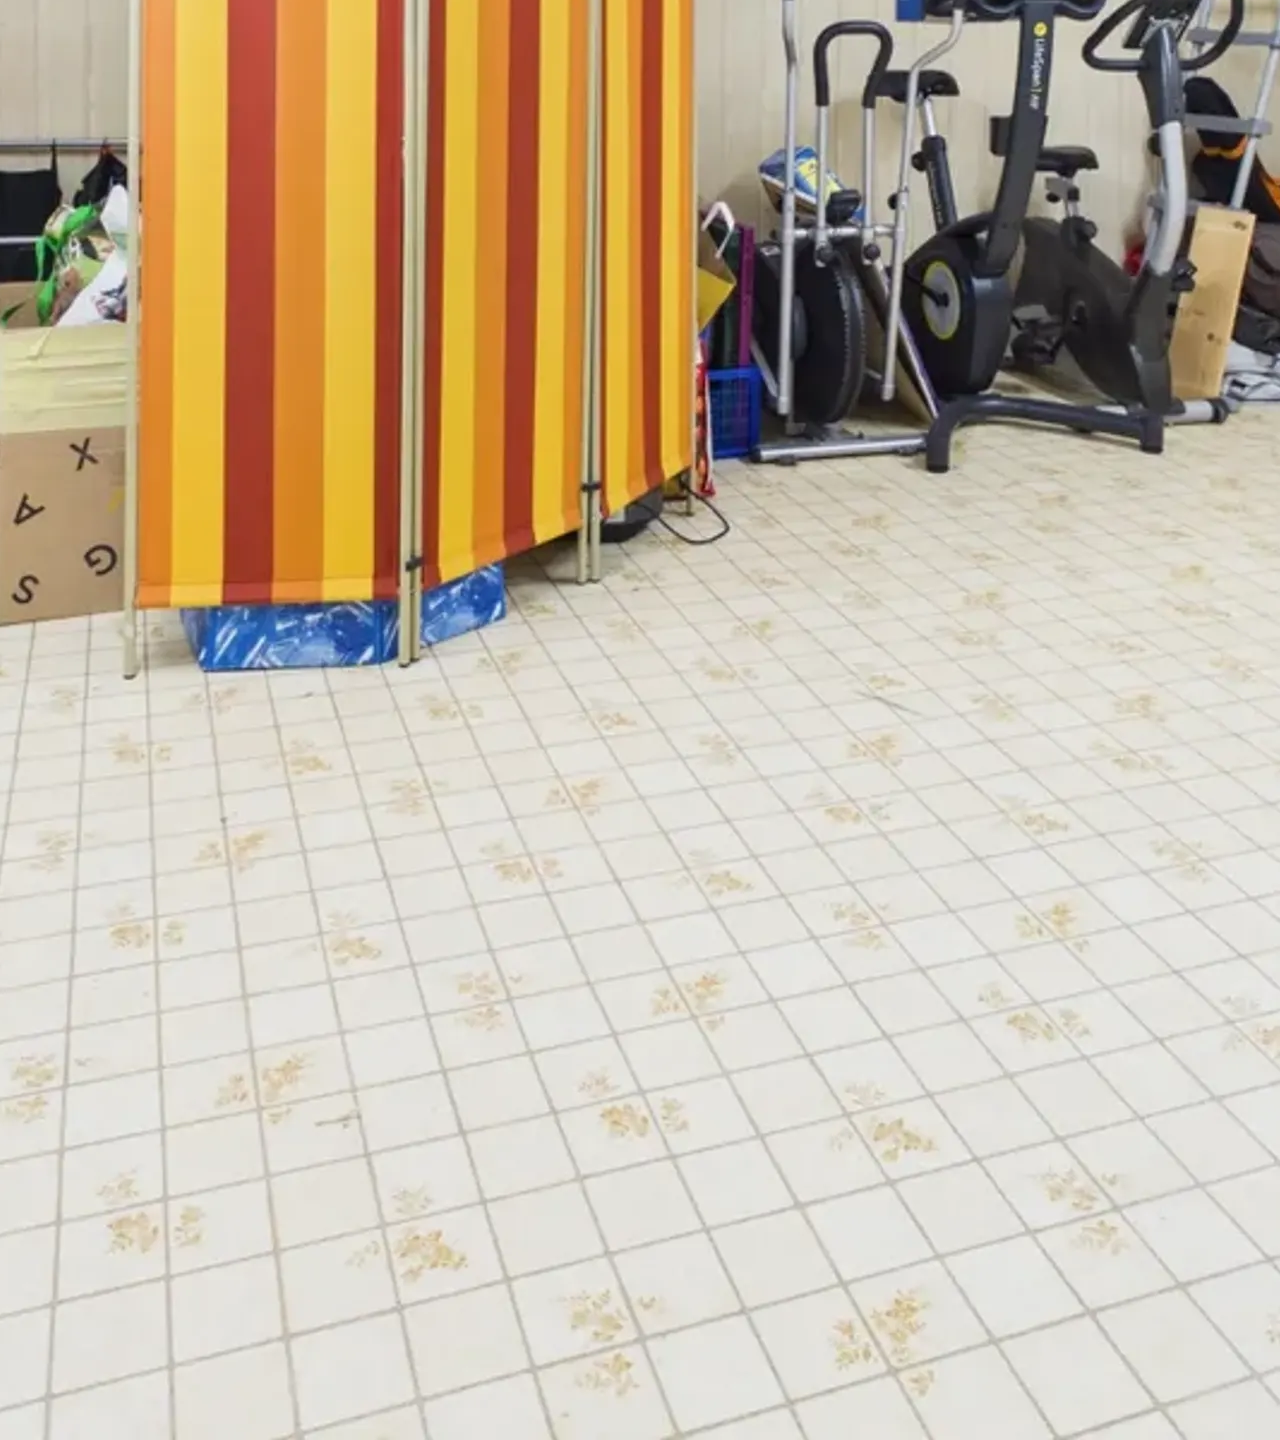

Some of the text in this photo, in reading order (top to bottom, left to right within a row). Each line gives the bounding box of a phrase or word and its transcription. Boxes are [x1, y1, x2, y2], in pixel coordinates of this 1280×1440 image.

[1030, 38, 1046, 87] LifeSpan
[70, 438, 98, 471] X
[14, 494, 45, 525] A
[84, 545, 117, 576] G
[12, 575, 39, 604] S
